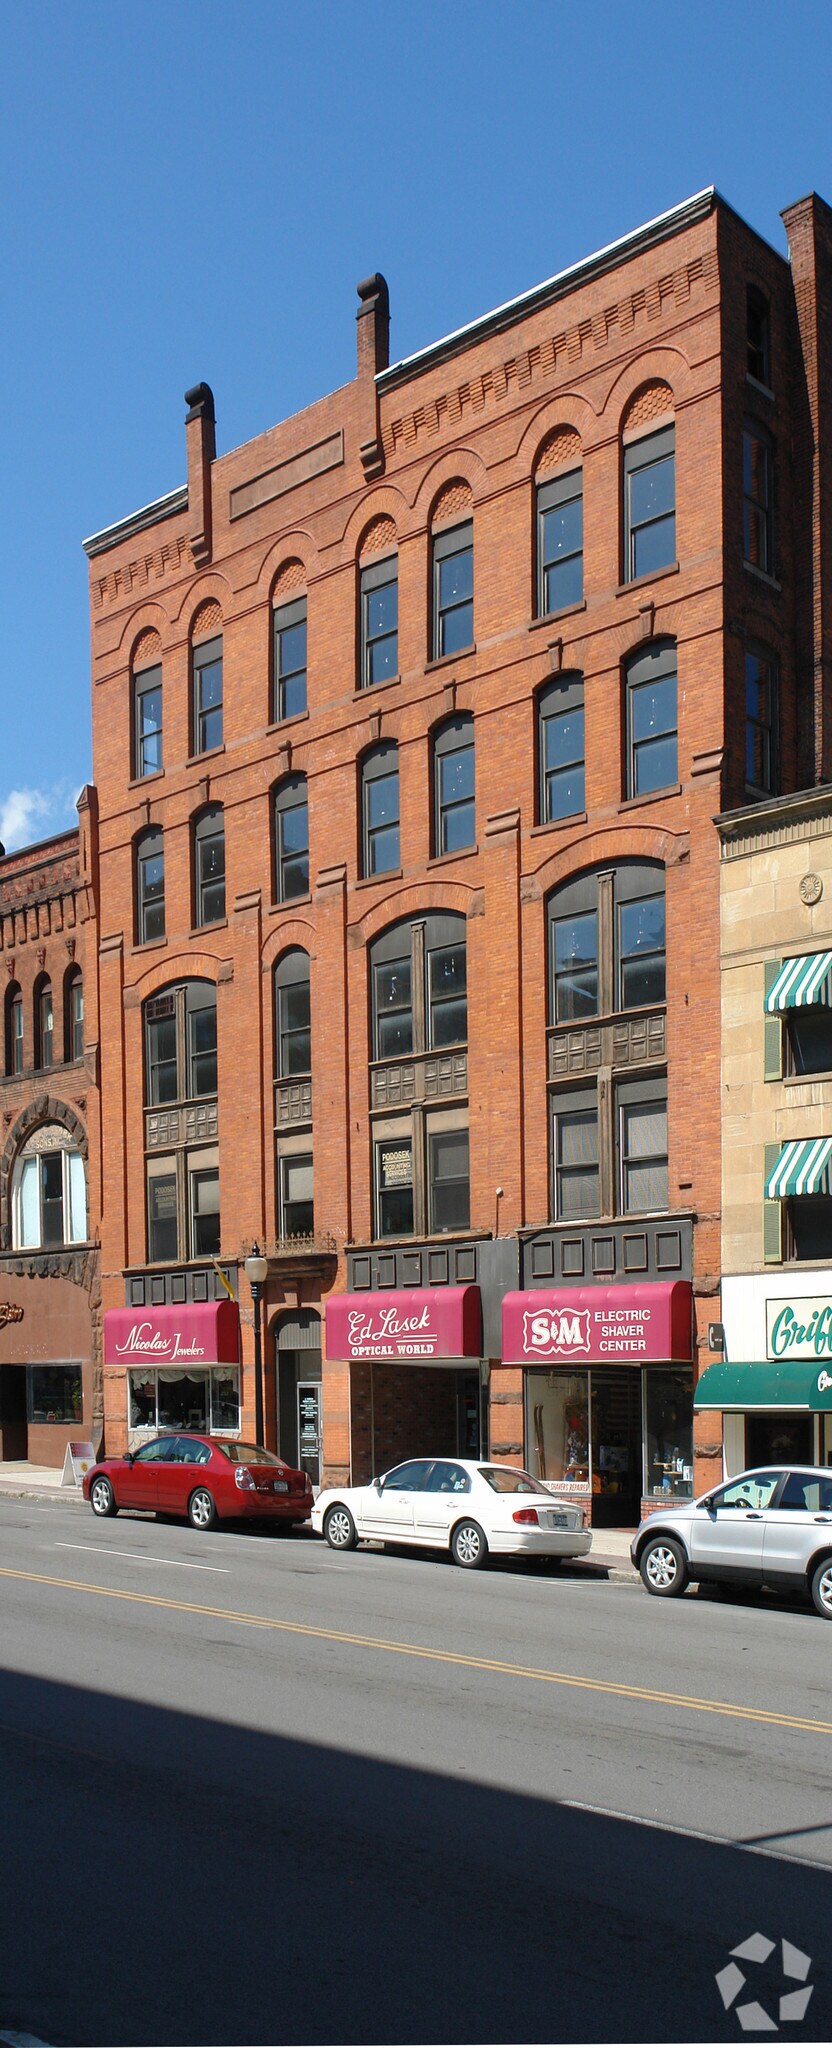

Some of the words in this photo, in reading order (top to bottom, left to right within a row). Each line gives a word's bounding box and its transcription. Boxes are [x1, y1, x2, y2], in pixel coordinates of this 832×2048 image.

[382, 1150, 410, 1161] PODOSEK
[594, 1309, 651, 1323] ELECTRIC
[347, 1310, 373, 1346] Ed
[371, 1305, 431, 1341] Lasek
[531, 1317, 584, 1345] S&M
[601, 1325, 644, 1337] SHAVER
[115, 1322, 171, 1351] Nicolas
[170, 1333, 205, 1360] Jewelers
[599, 1340, 646, 1352] CENTER
[351, 1345, 394, 1357] OPTICAL
[396, 1344, 434, 1355] WORLD
